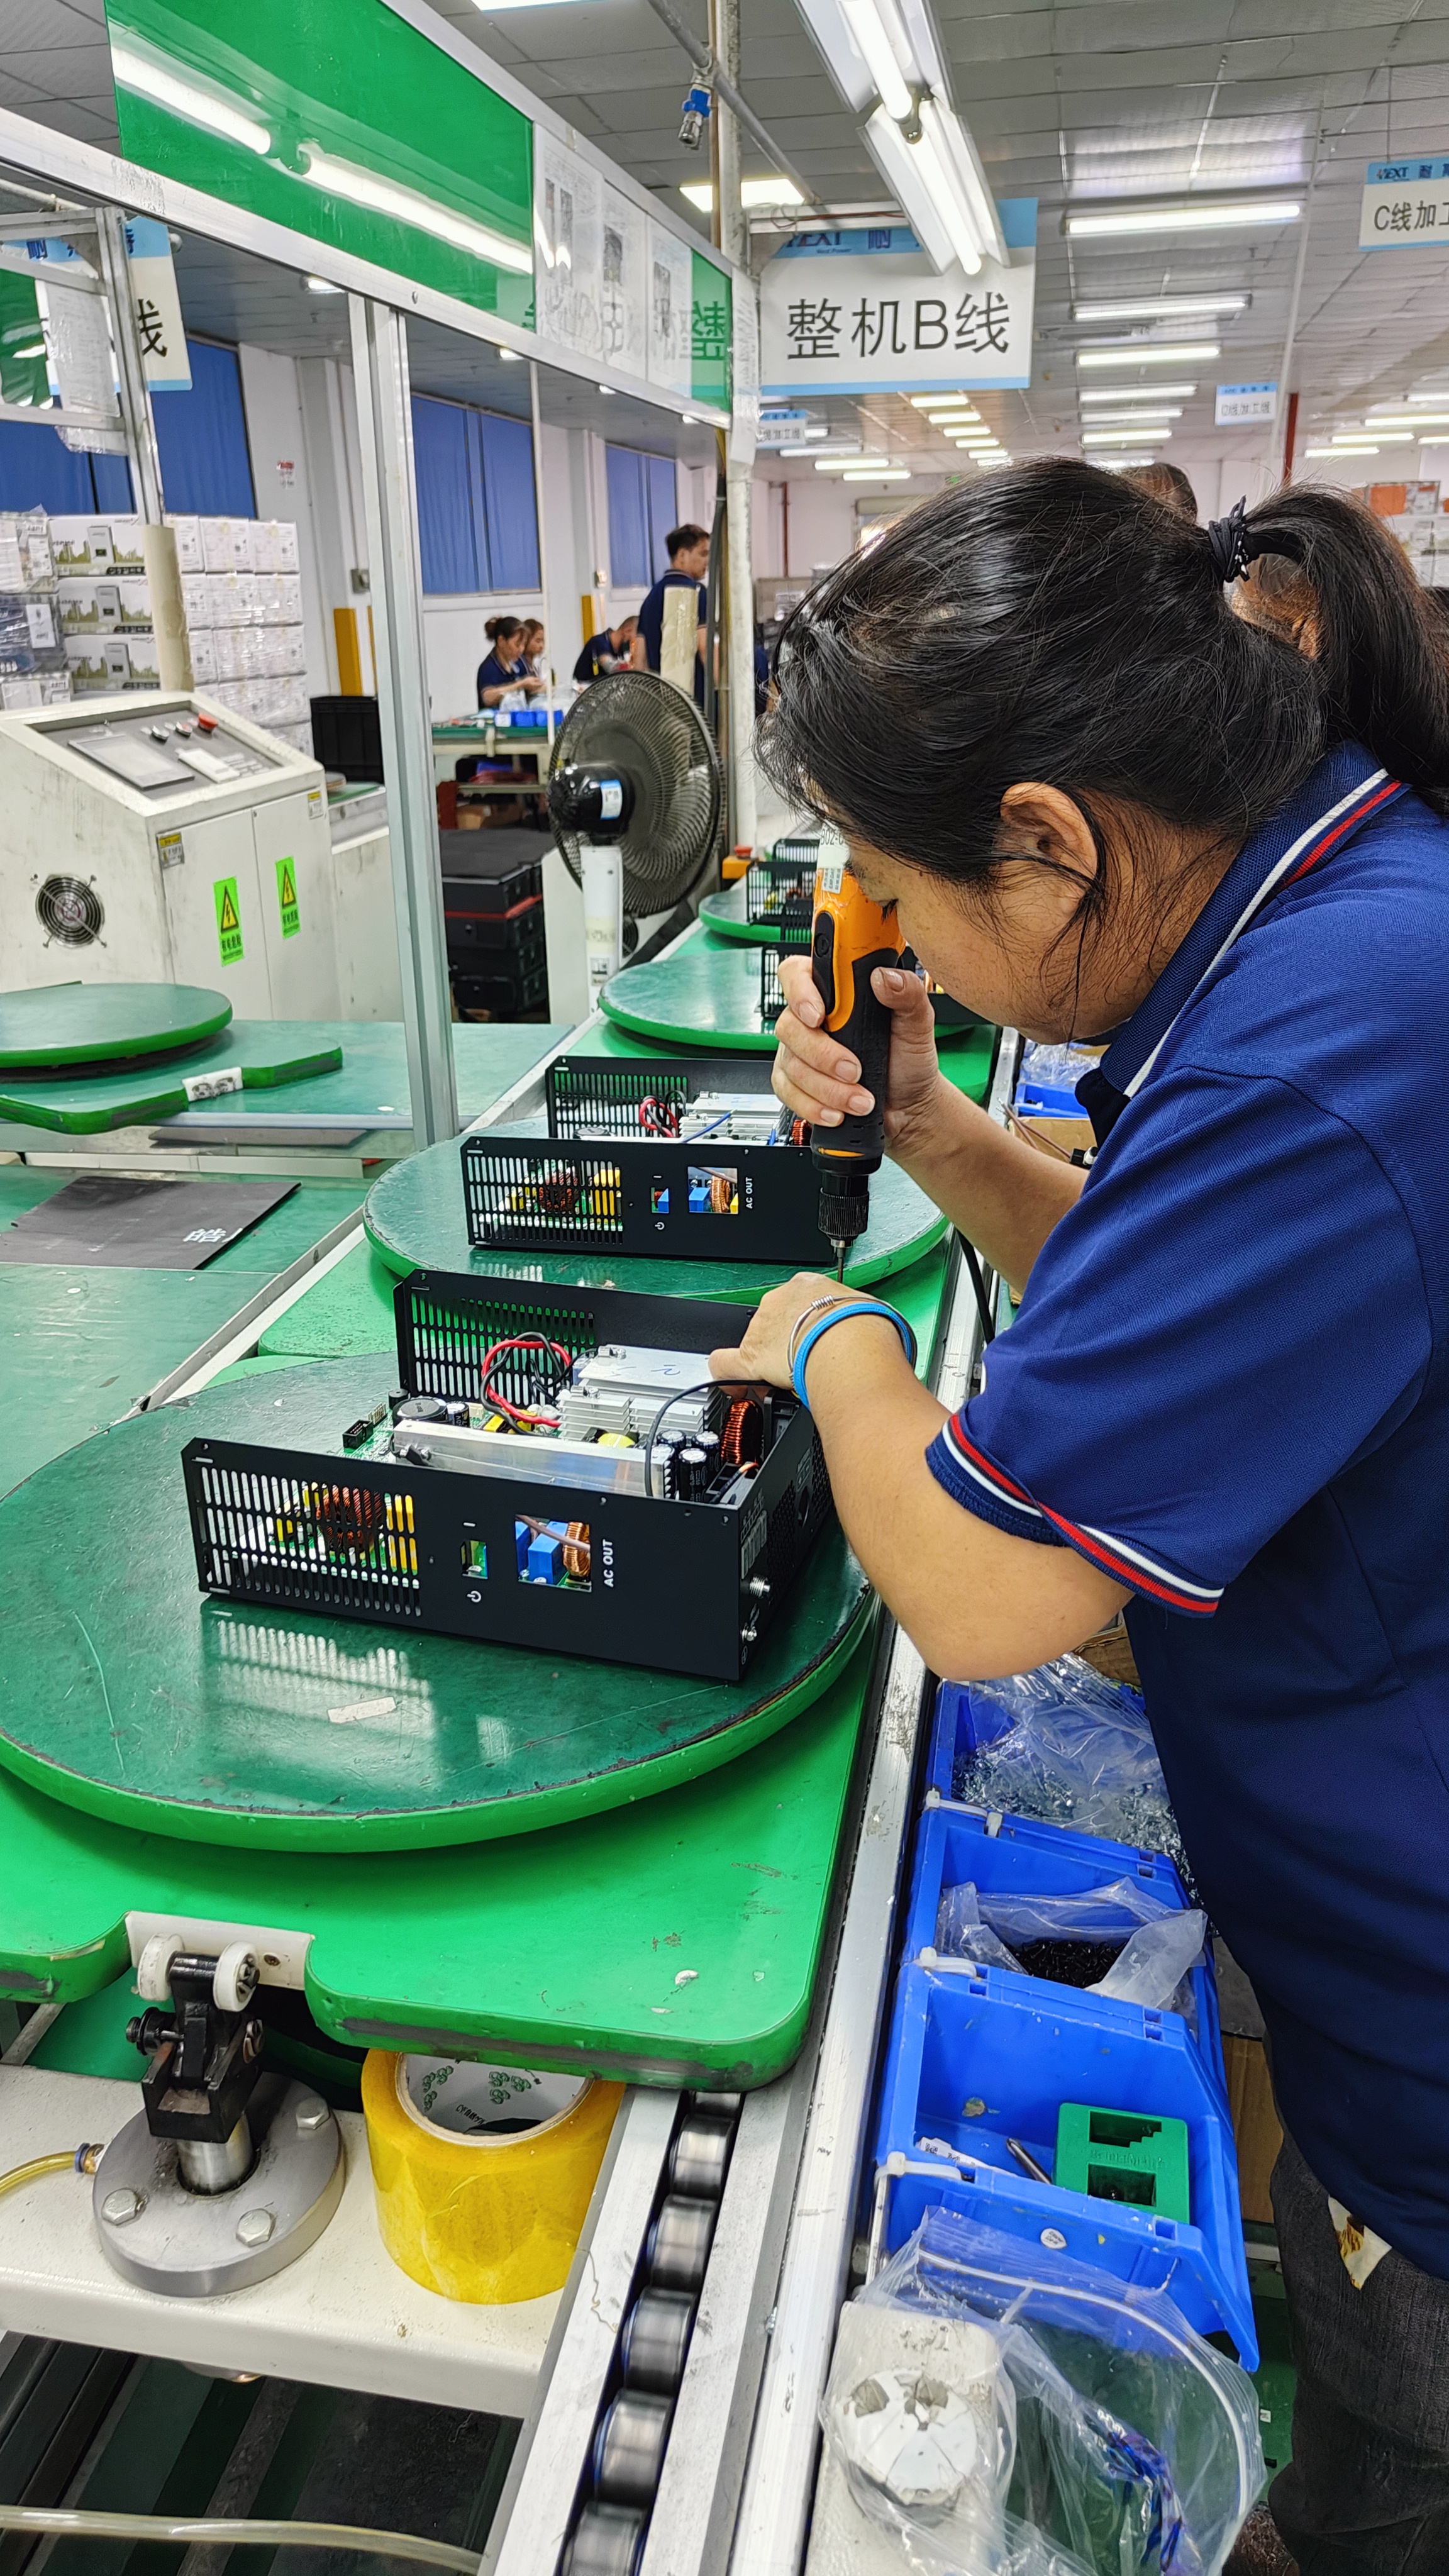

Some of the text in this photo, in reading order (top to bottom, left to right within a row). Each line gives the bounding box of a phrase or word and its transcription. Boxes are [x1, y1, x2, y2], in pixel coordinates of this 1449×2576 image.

[787, 292, 1011, 360] 整机B线
[745, 1177, 753, 1209] AC OUT
[602, 1538, 614, 1587] AC OUT
